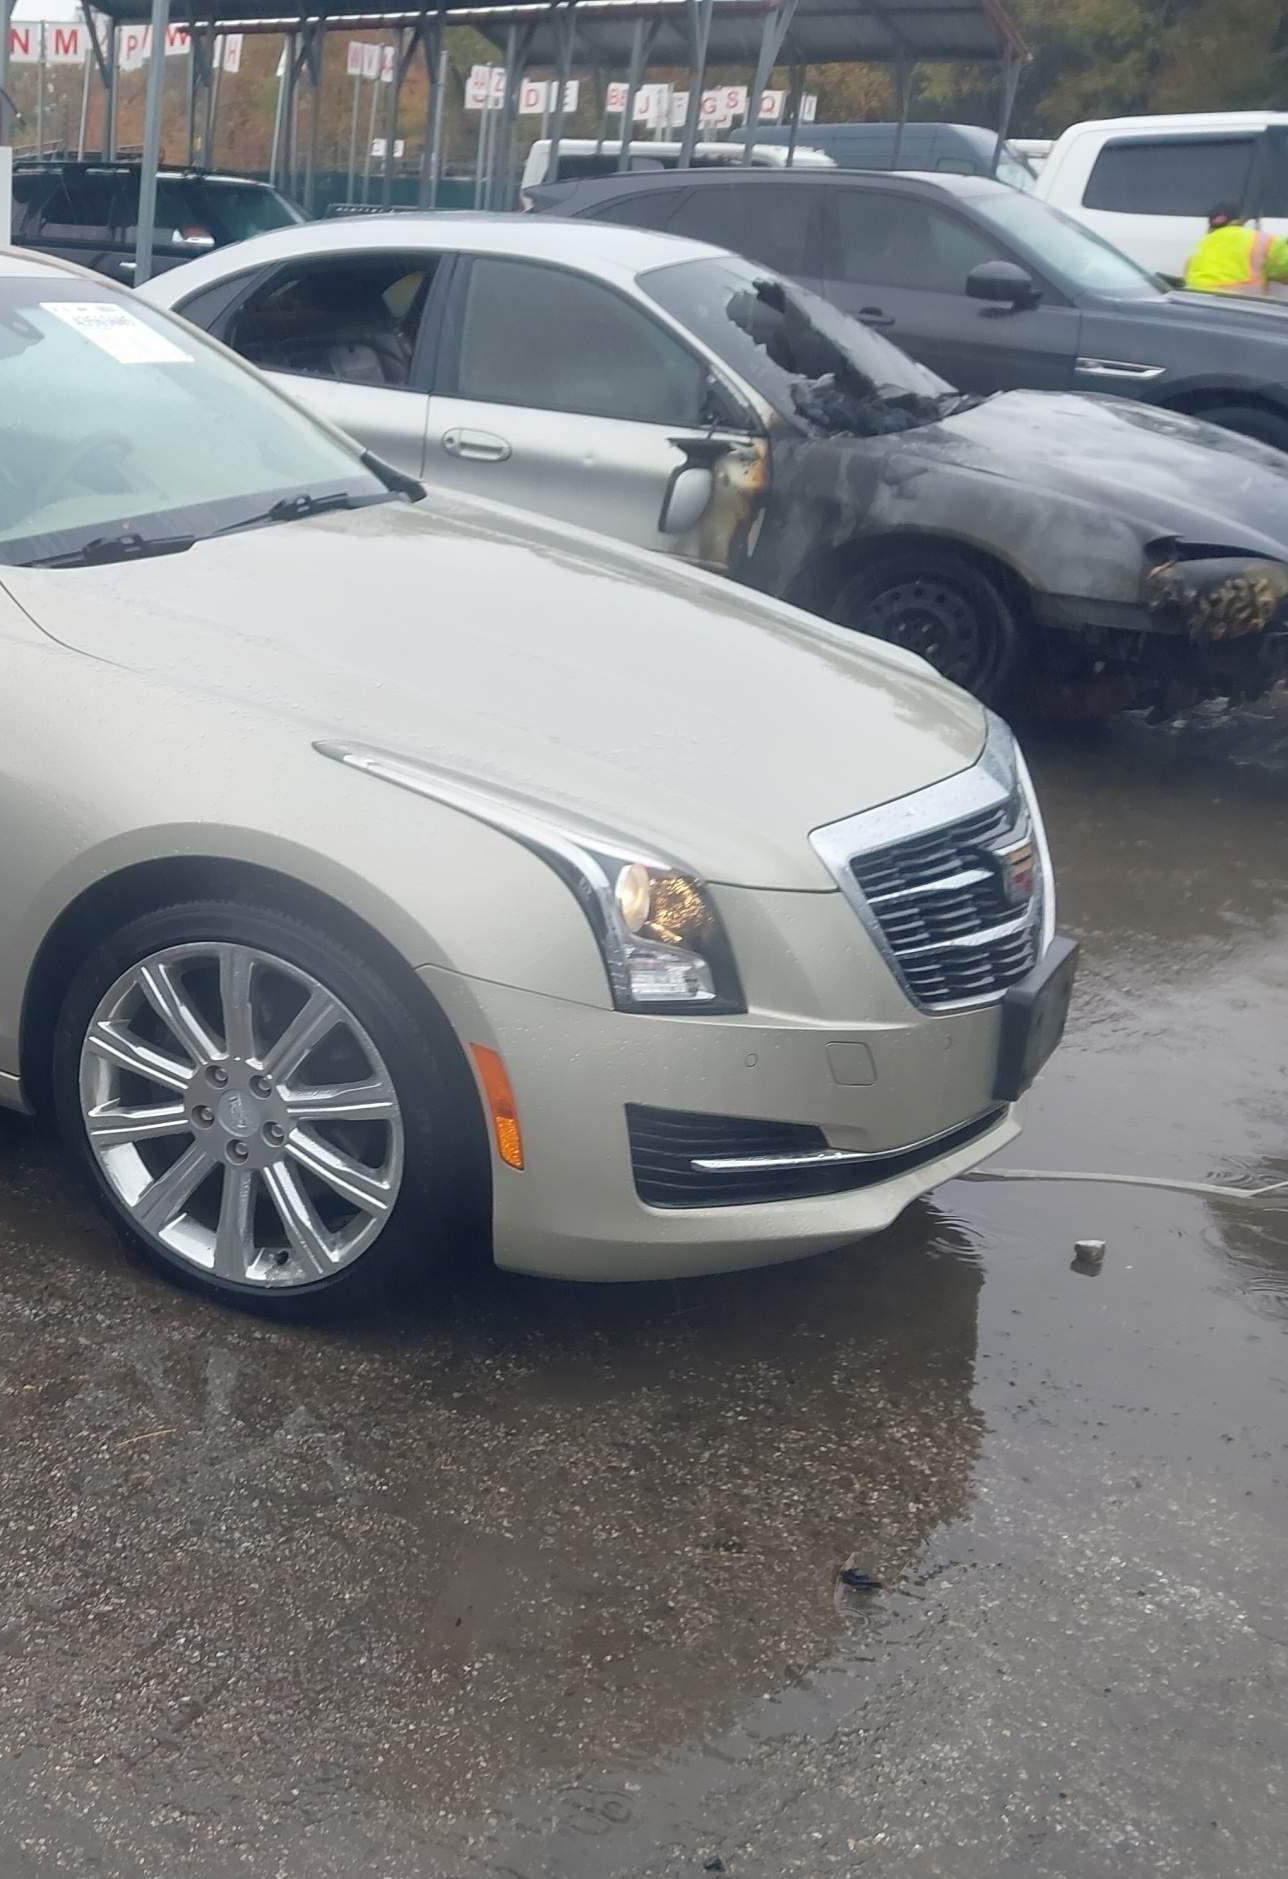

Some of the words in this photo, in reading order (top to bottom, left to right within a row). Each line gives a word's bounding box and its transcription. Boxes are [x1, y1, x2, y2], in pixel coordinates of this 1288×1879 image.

[9, 28, 30, 55] N
[54, 28, 78, 56] M
[524, 88, 541, 108] D
[702, 96, 718, 114] G
[726, 90, 739, 109] S
